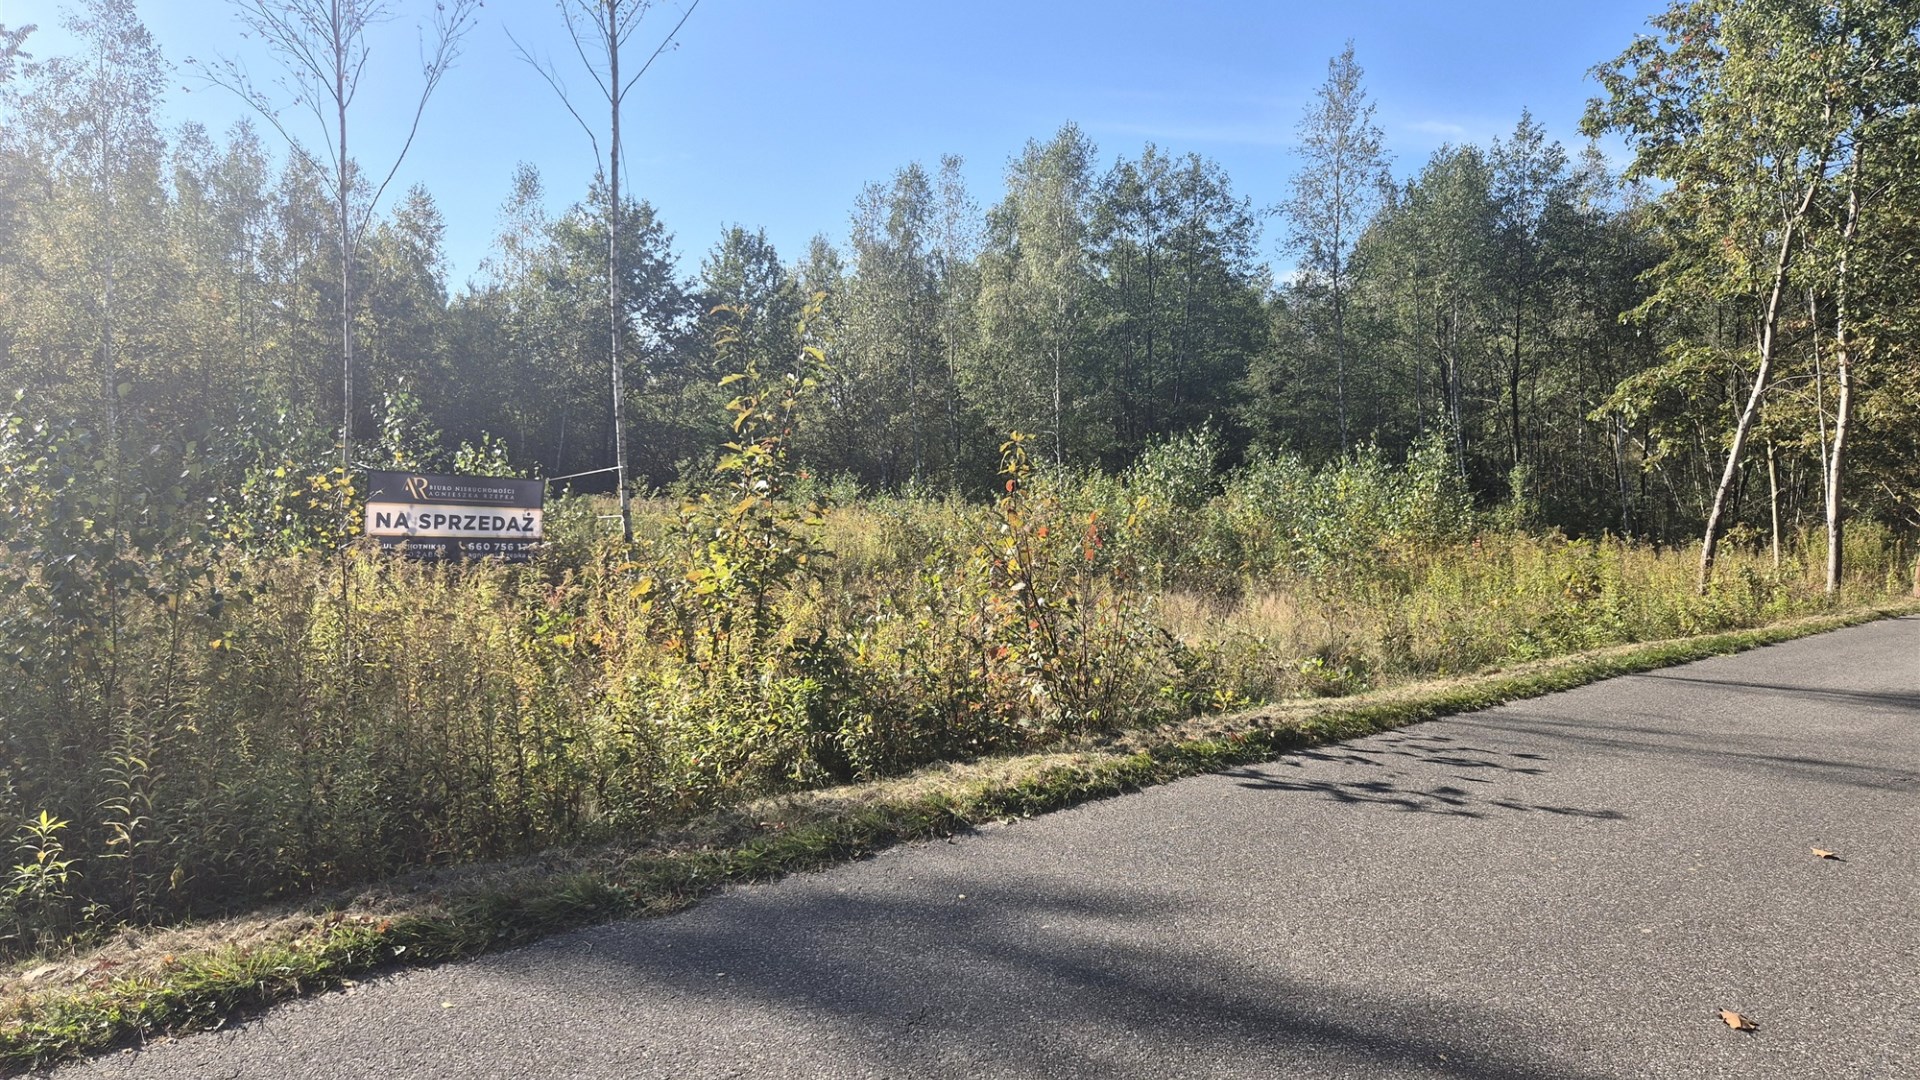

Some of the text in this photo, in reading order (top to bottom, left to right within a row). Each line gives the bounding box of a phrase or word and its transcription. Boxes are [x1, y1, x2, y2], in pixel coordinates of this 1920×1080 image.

[376, 512, 534, 532] NA SPRZEDAŻ
[468, 542, 490, 551] 660
[494, 543, 514, 551] 756
